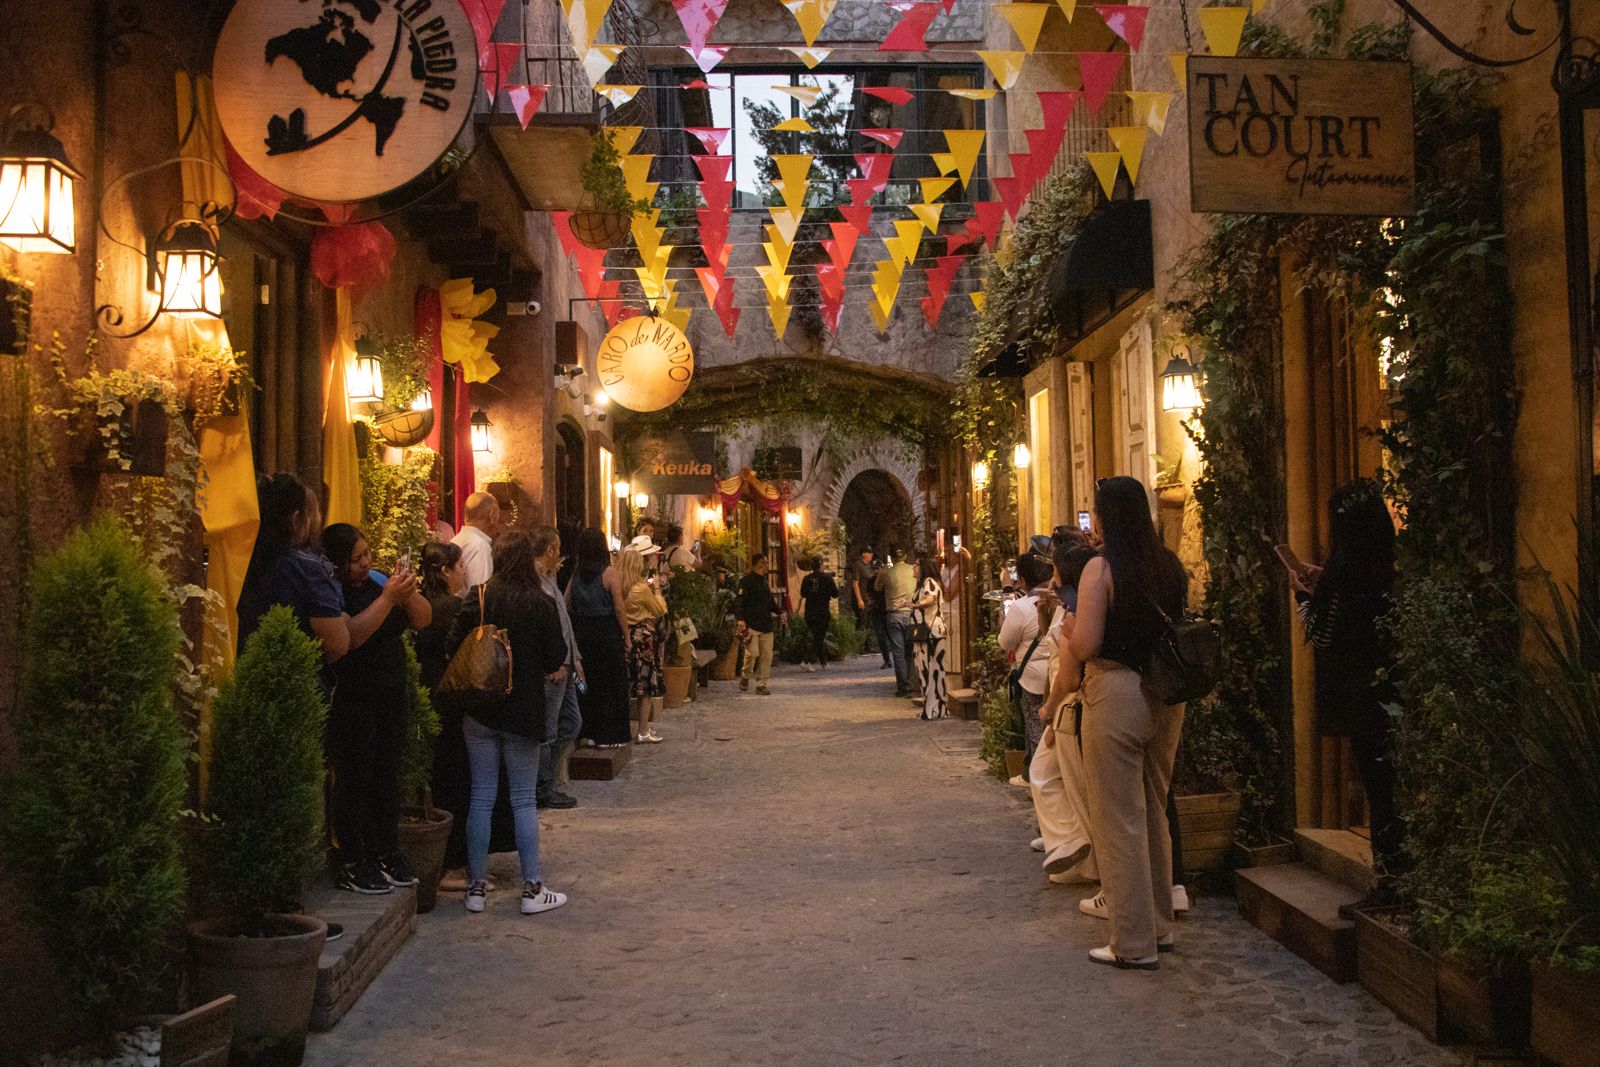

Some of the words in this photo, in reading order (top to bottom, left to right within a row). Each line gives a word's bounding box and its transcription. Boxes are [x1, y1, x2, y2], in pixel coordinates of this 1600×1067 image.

[416, 16, 457, 112] PIEDRA
[1196, 73, 1300, 115] TAN
[1204, 112, 1381, 158] COURT
[601, 335, 628, 386] CARO
[652, 323, 691, 382] NARDO
[652, 460, 713, 476] Keuka
